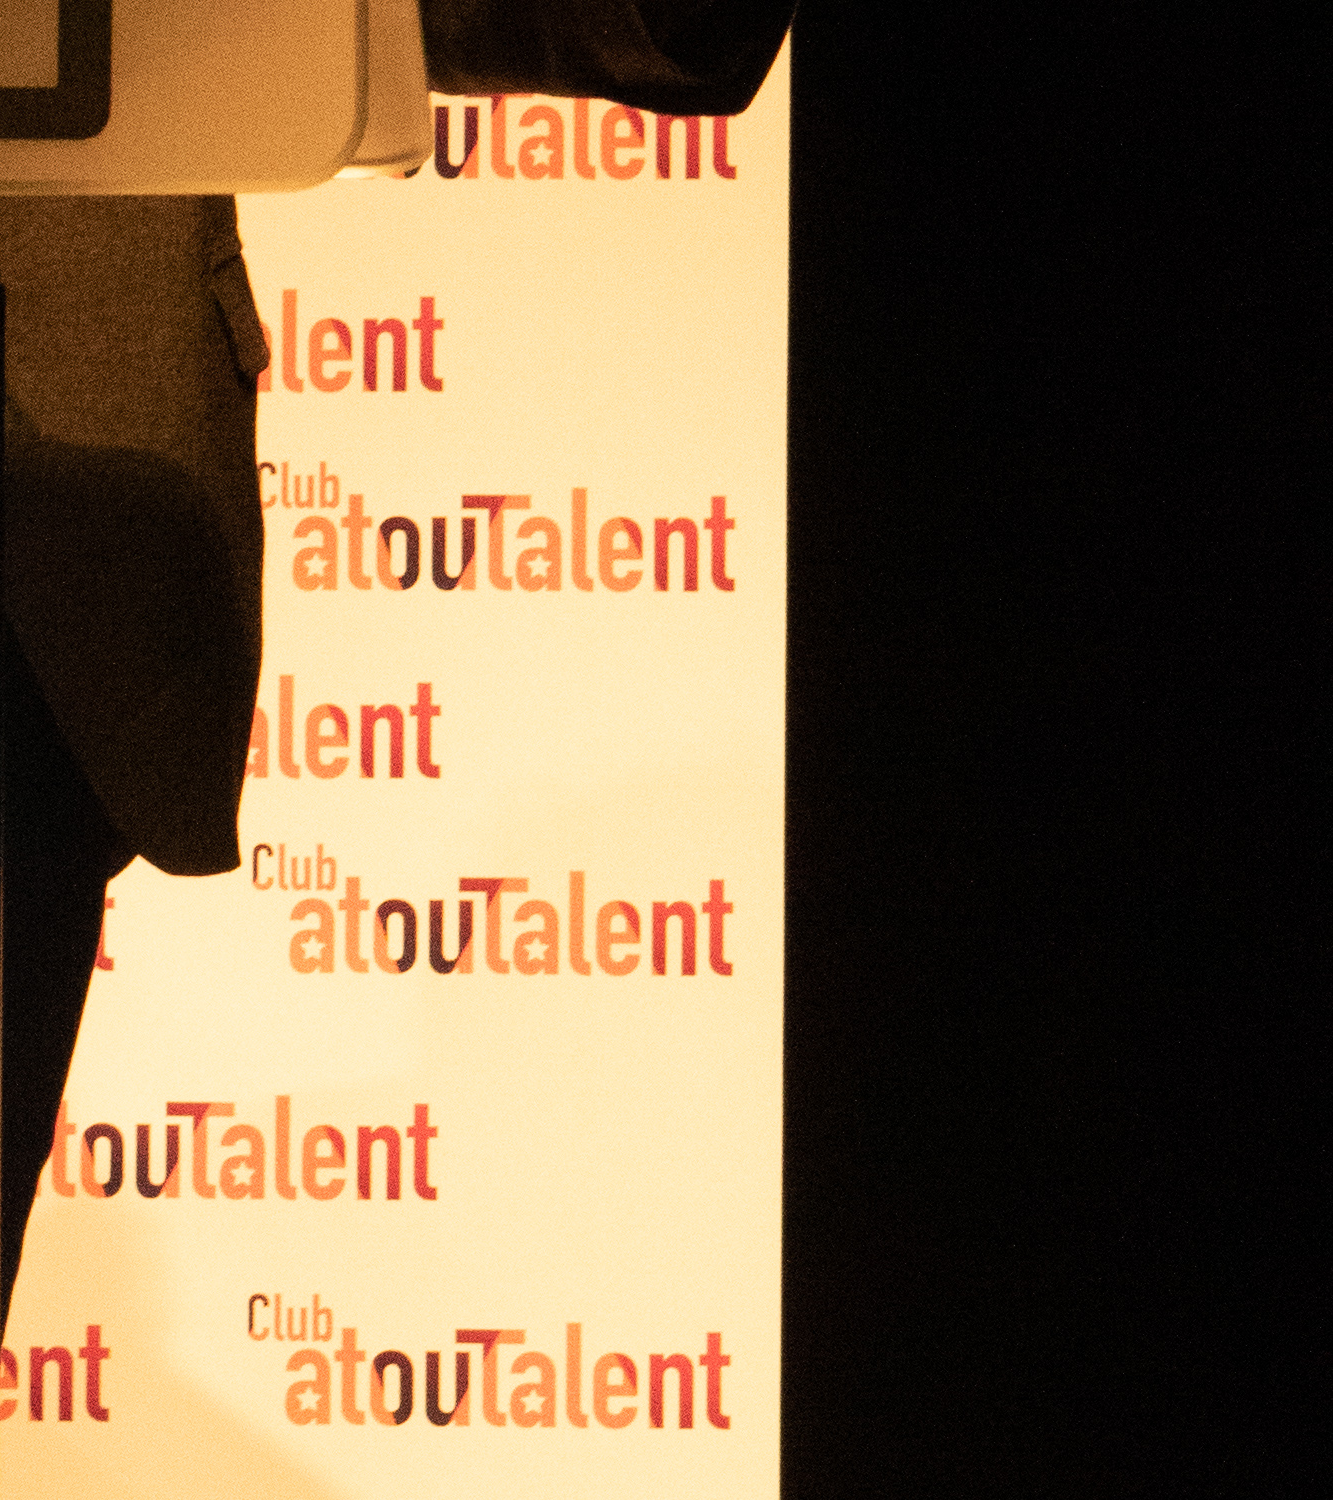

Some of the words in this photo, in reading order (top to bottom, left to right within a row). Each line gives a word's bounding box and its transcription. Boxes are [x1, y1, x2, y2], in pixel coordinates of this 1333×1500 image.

[403, 93, 737, 180] uTalent
[292, 488, 736, 592] atouTalent
[252, 844, 337, 891] Club
[289, 871, 734, 977] atouTalent
[48, 1095, 438, 1201] touTalent
[248, 1293, 333, 1342] Club
[284, 1323, 731, 1430] atouTalent
